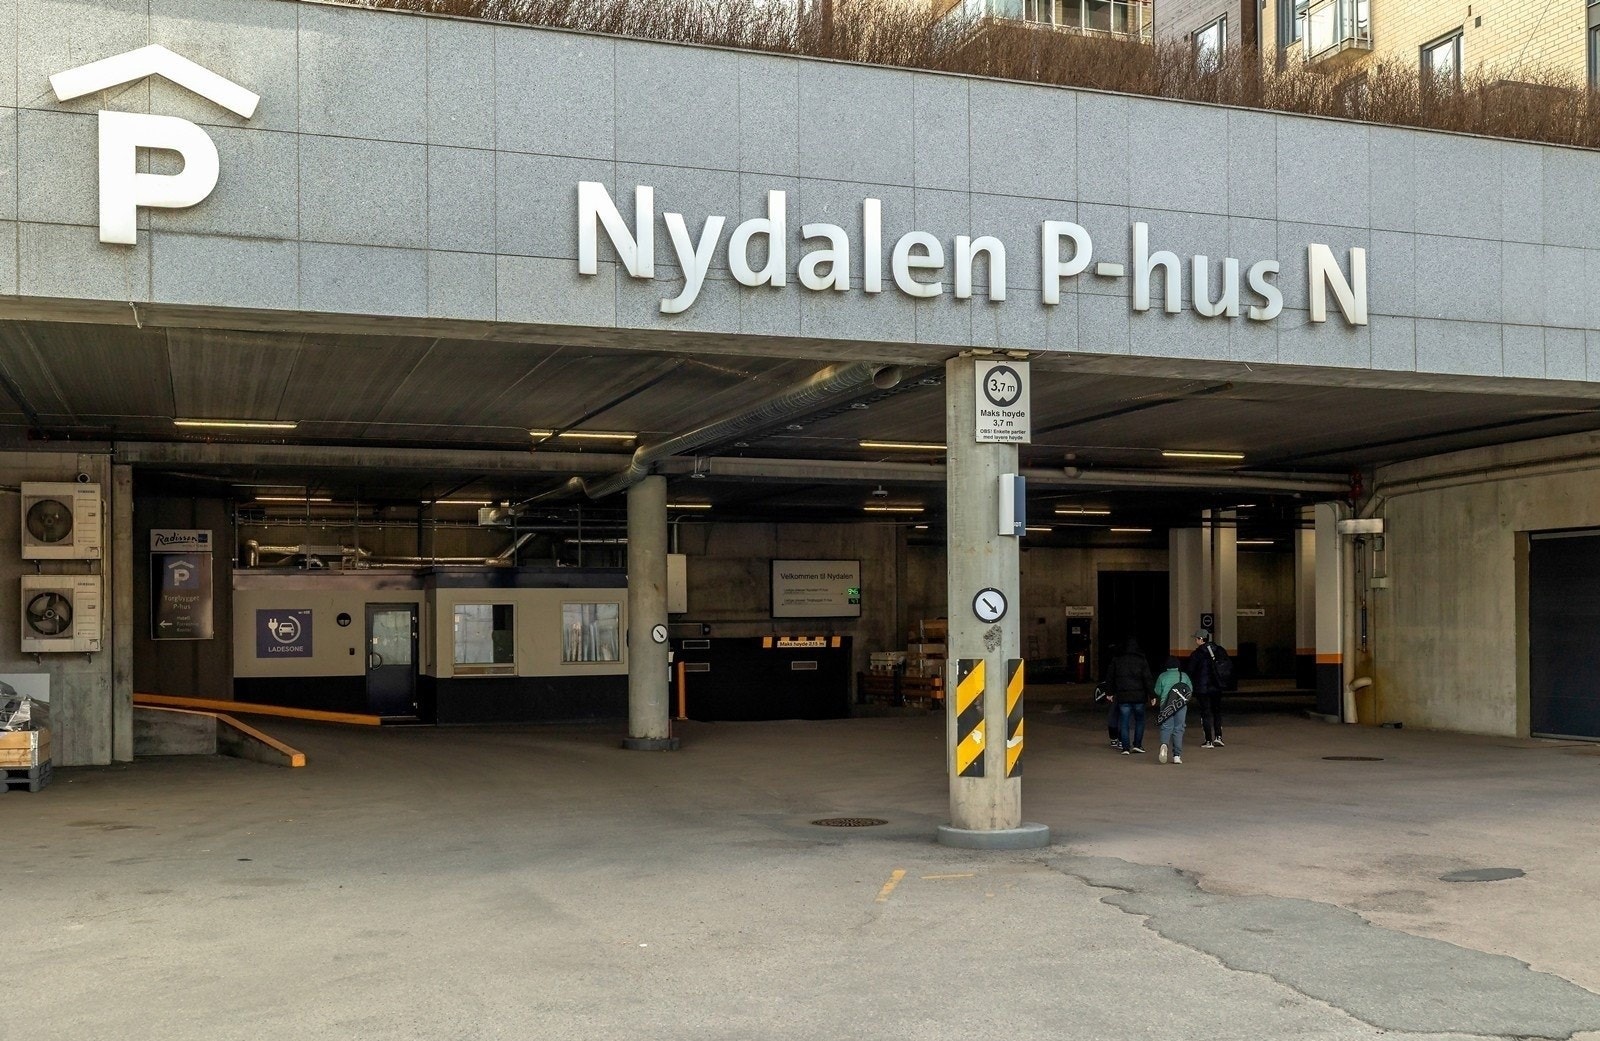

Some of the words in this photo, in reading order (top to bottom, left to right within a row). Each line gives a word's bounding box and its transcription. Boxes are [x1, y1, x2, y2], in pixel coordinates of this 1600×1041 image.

[98, 110, 220, 245] P
[577, 180, 1007, 314] Nydalen
[1041, 220, 1284, 321] P-hus
[1308, 243, 1368, 326] N
[990, 379, 1006, 392] 3,7
[980, 409, 1000, 417] Maks
[1002, 410, 1026, 419] høyde
[993, 419, 1004, 427] 3,7
